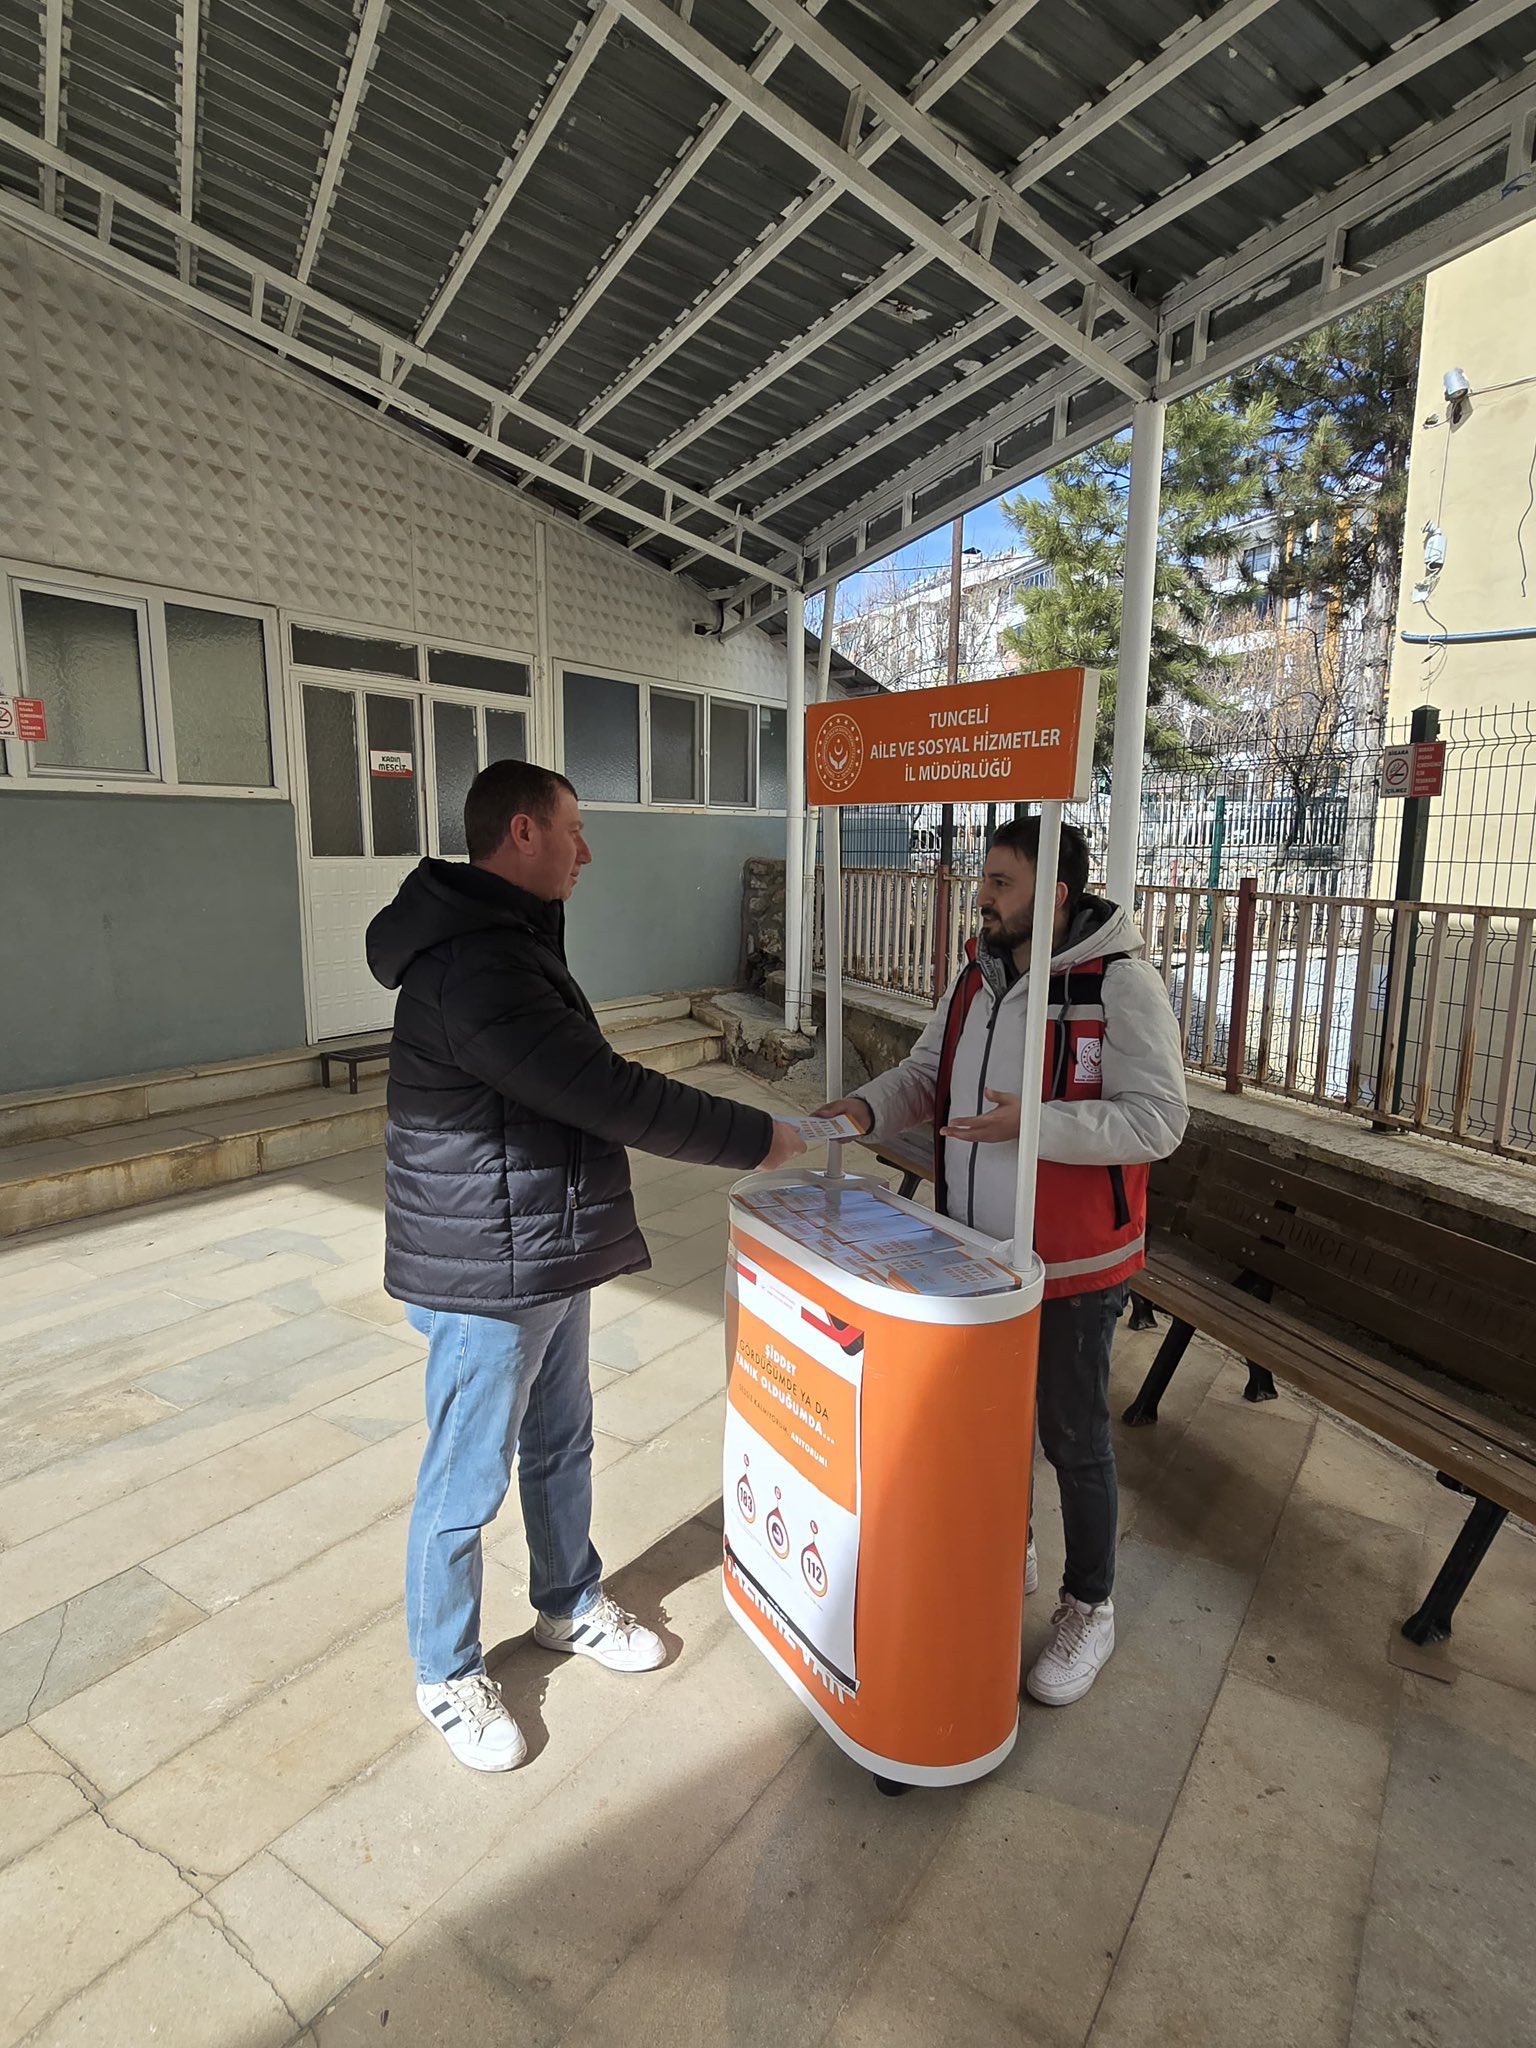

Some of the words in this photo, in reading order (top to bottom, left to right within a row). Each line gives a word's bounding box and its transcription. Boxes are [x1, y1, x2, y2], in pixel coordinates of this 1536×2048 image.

[929, 703, 989, 729] TUNCELİ
[870, 741, 897, 760] AİLE
[899, 741, 915, 757] VE
[918, 736, 970, 756] SOSYAL
[973, 728, 1061, 752] HİZMETLER
[905, 763, 916, 782] İL
[919, 757, 1012, 781] MÜDÜRLÜĞÜ
[735, 1350, 759, 1382] TANIK
[765, 1343, 797, 1377] ŞİDDET
[801, 1389, 812, 1408] YA
[815, 1401, 829, 1421] DA
[740, 1487, 753, 1513] 183
[806, 1558, 823, 1585] 112
